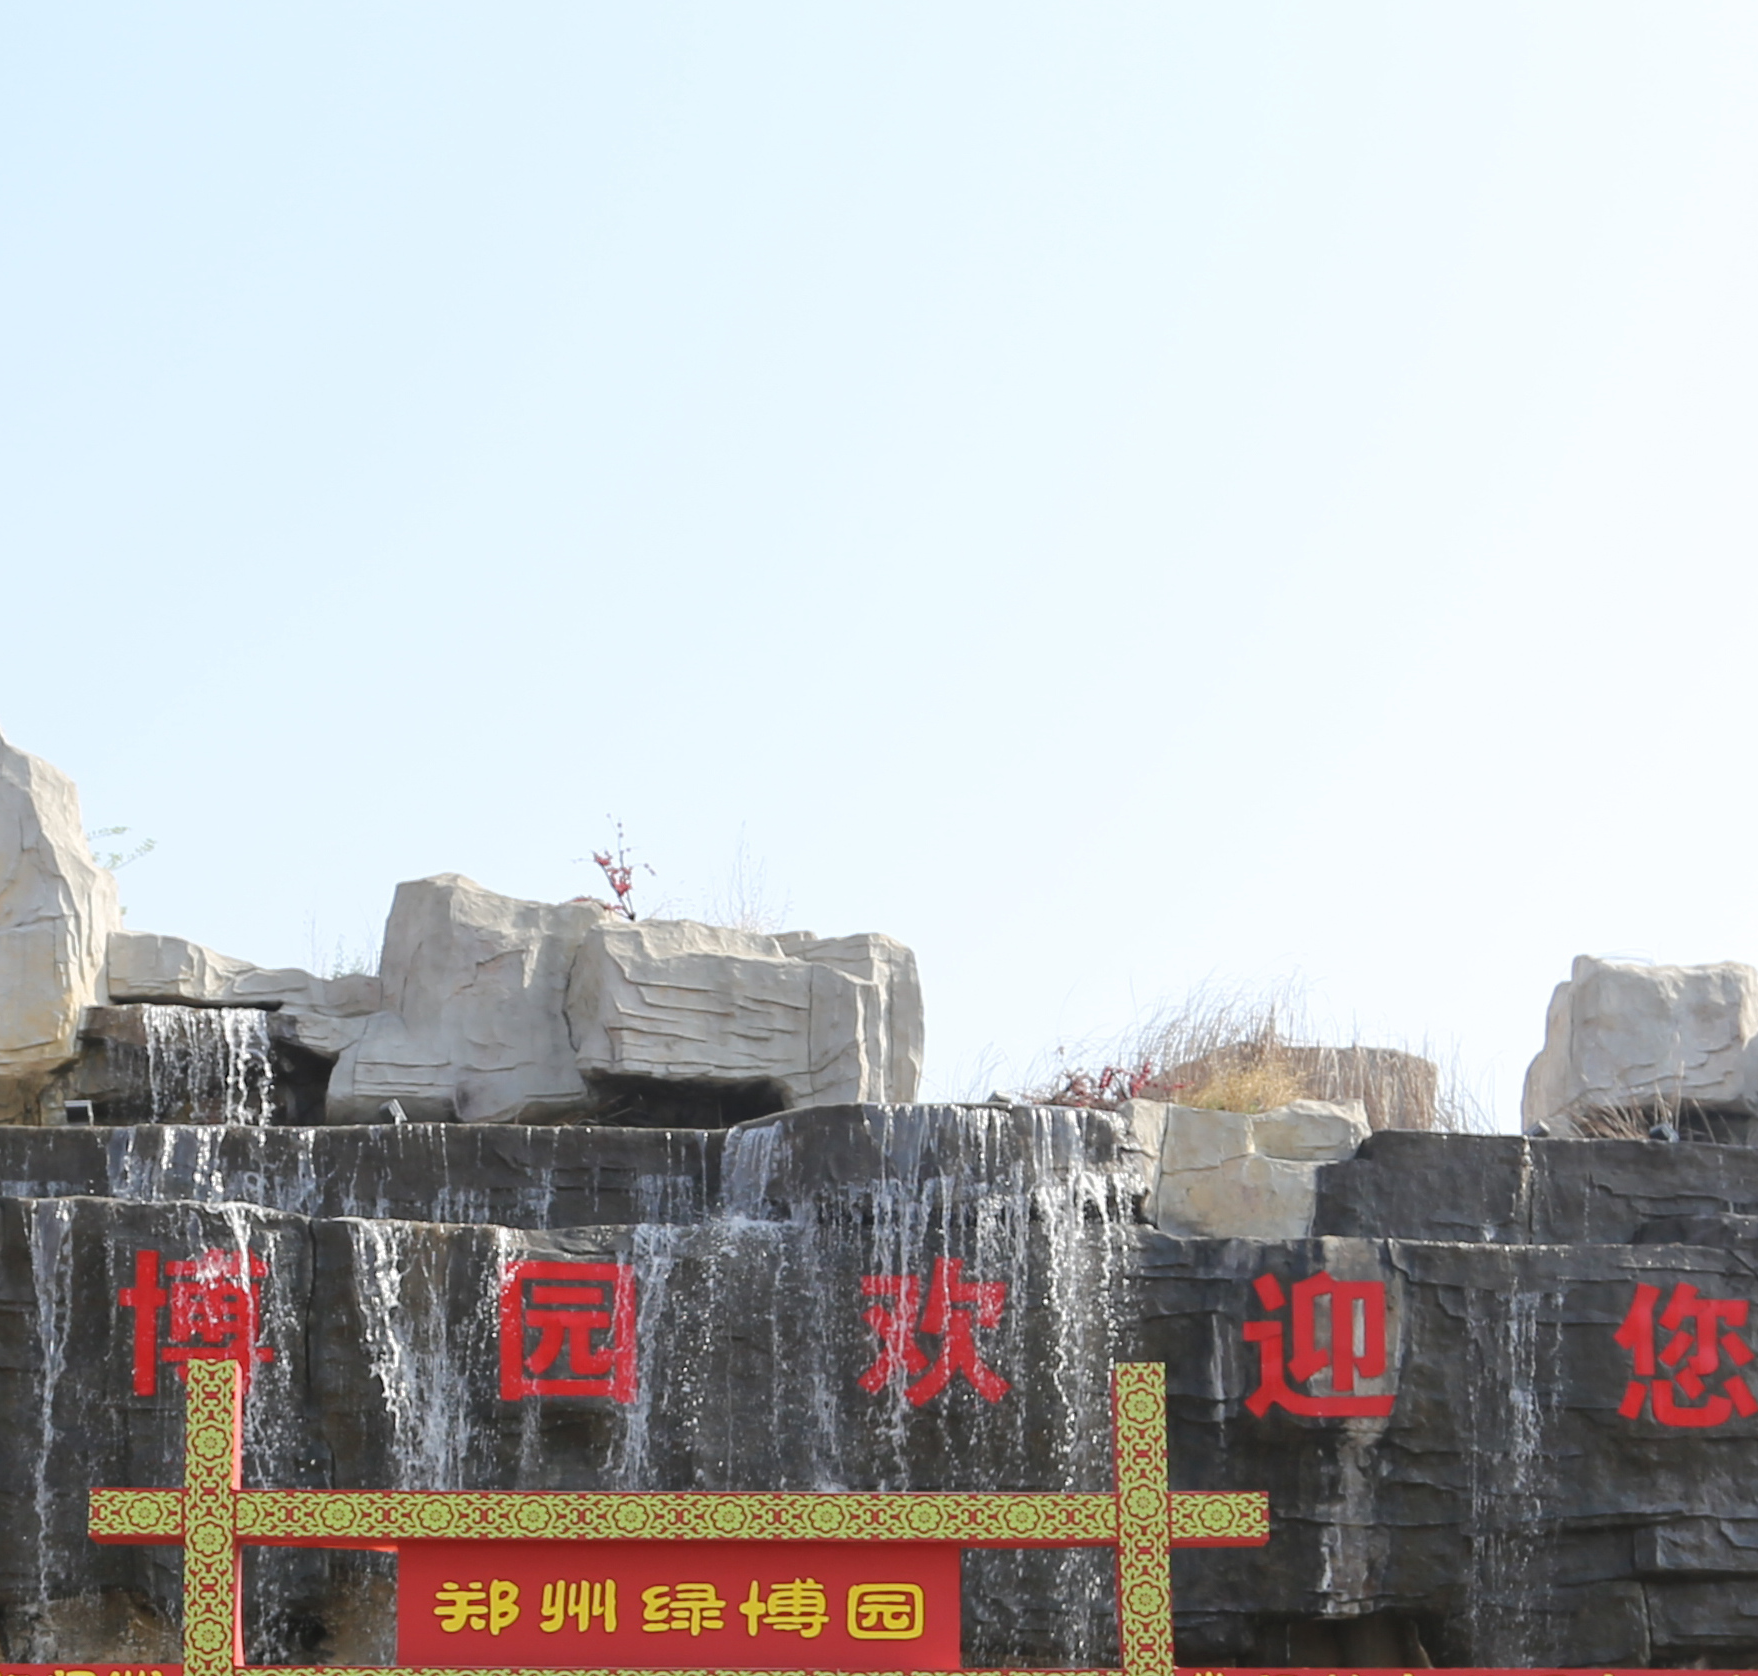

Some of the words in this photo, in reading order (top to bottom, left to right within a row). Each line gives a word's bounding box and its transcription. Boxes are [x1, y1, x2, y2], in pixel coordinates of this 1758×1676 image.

[434, 1577, 926, 1640] 郑州绿博园
